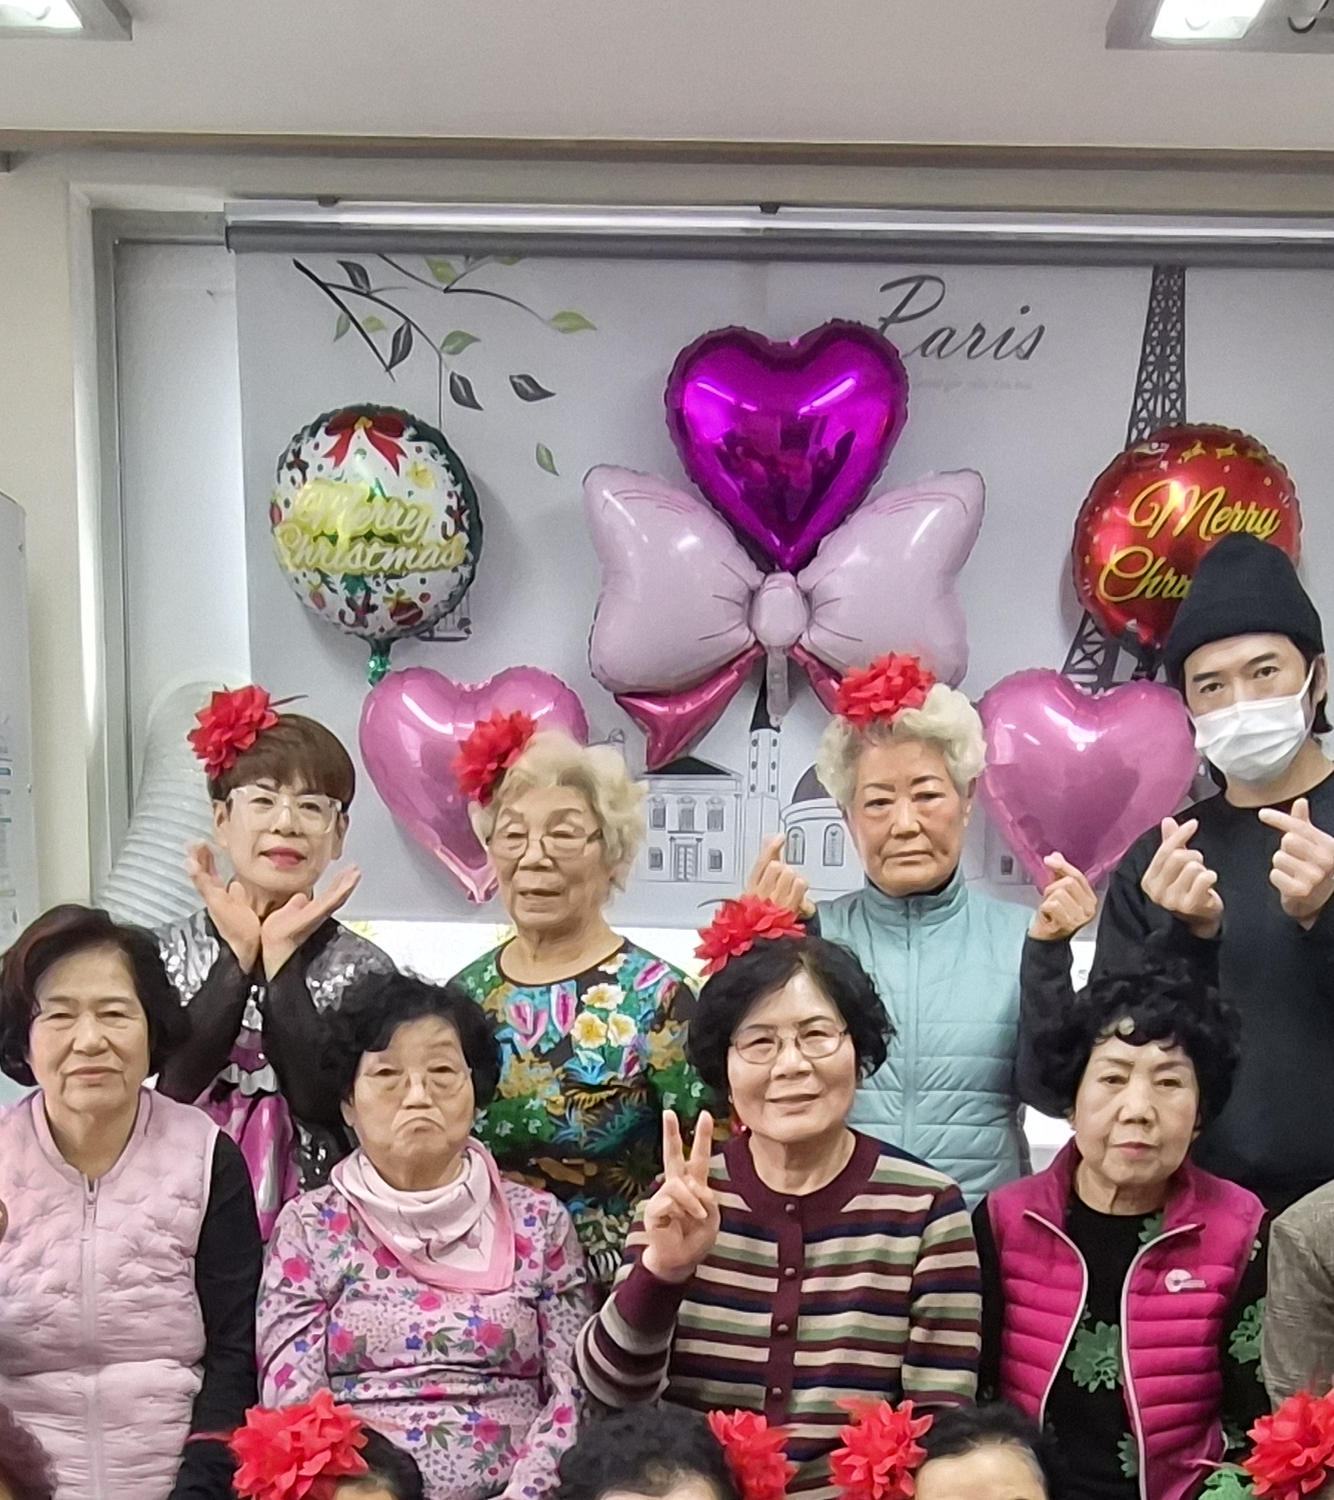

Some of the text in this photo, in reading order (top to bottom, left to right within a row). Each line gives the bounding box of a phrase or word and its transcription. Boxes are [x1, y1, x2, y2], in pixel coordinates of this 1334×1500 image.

[878, 274, 1045, 360] Paris
[1128, 479, 1281, 541] Merry
[273, 523, 469, 571] Christmas
